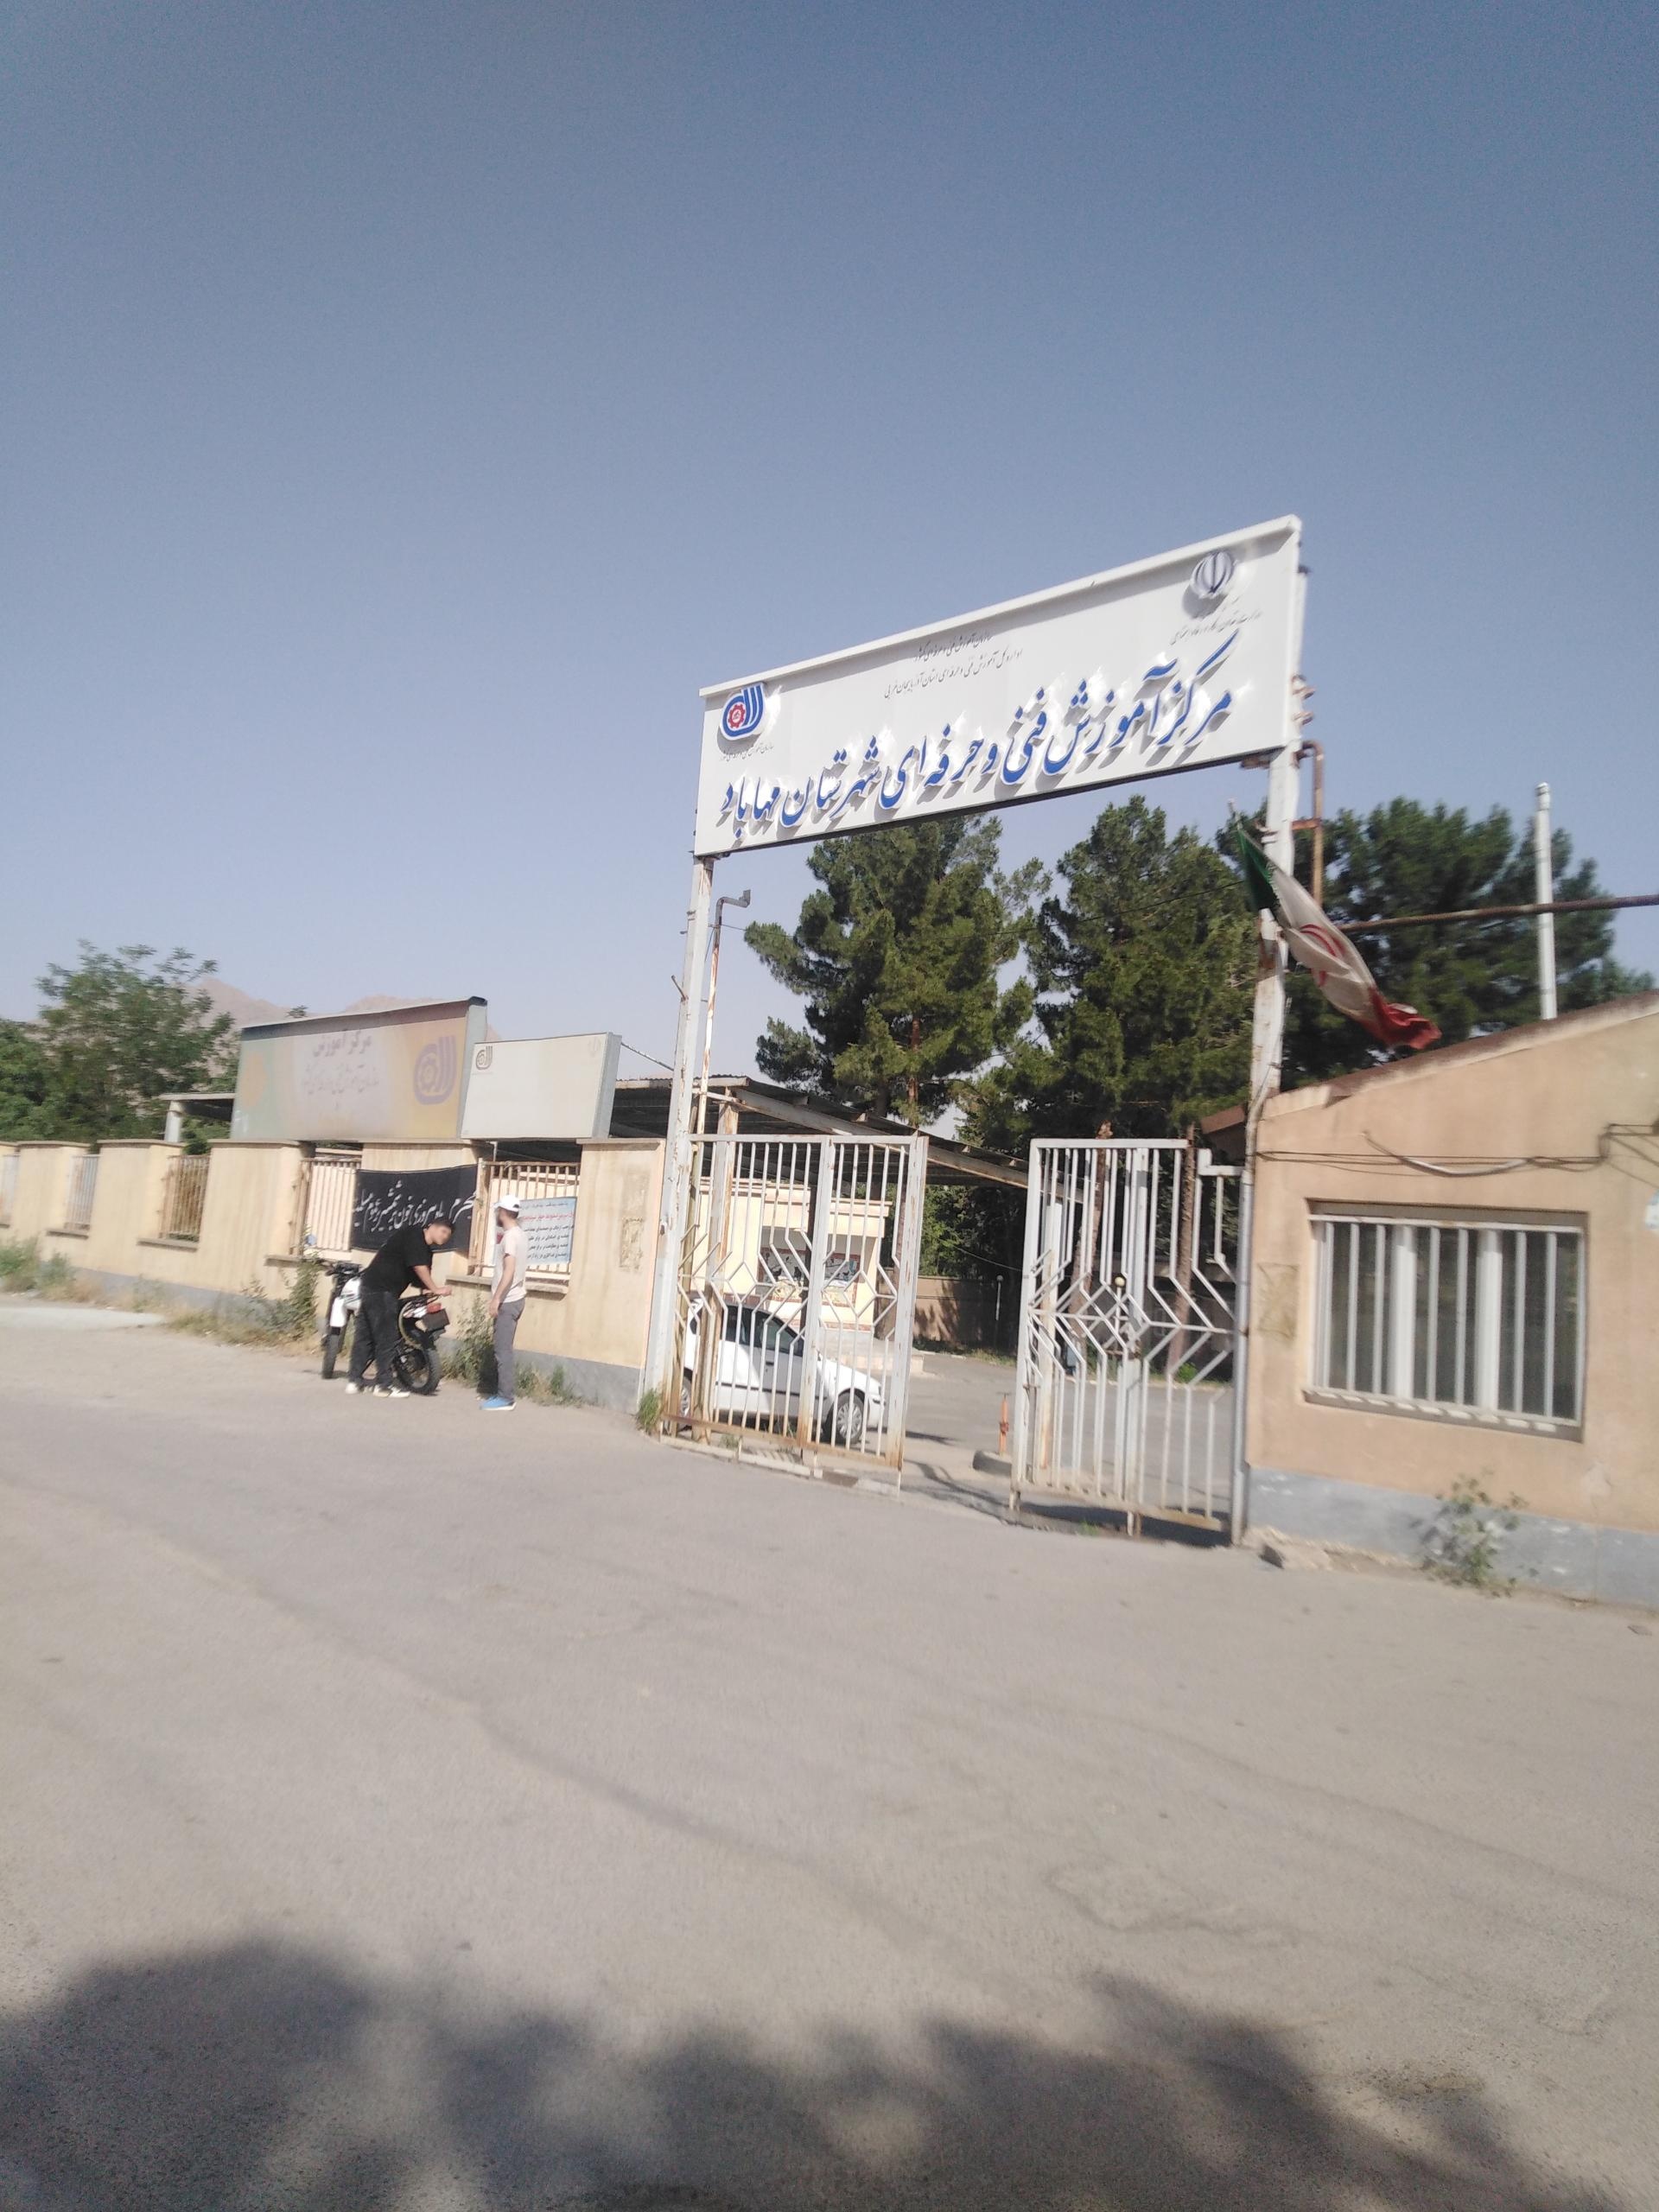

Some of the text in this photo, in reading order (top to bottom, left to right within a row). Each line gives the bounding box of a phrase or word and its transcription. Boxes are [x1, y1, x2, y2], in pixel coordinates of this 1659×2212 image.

[1002, 686, 1047, 784] فنی
[1043, 658, 1179, 775] آموزش
[1157, 628, 1240, 747] مرکز
[780, 734, 880, 827] شهرستان
[982, 743, 999, 774] و
[721, 777, 779, 838] مهاباد
